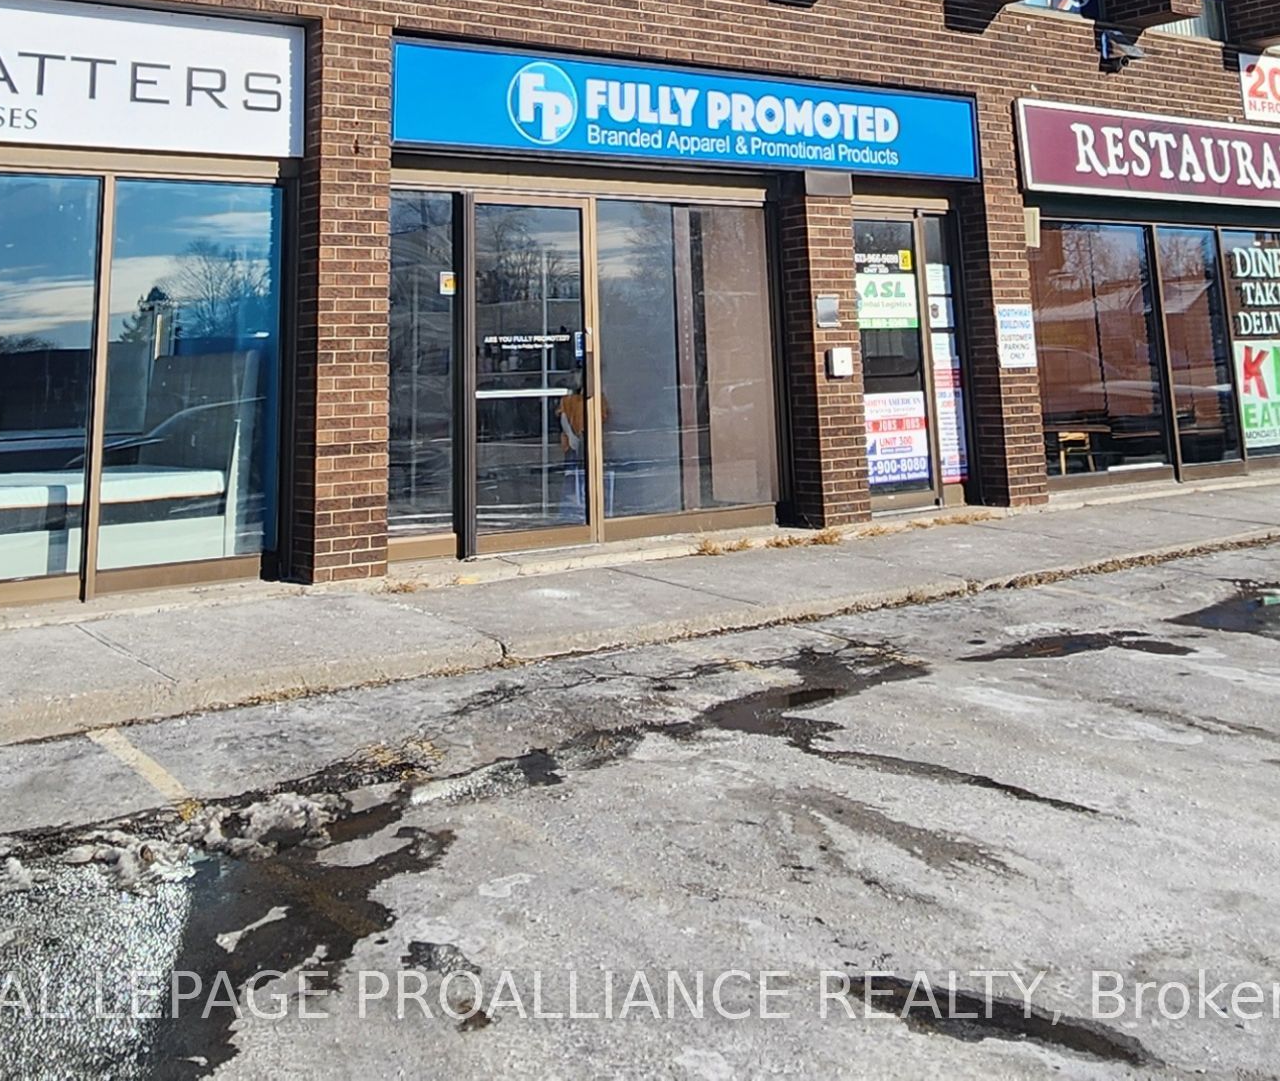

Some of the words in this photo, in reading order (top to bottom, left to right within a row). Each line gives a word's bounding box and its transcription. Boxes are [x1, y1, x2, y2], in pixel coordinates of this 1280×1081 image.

[586, 78, 699, 128] FULLY
[707, 90, 900, 144] PROMOTED
[587, 124, 662, 149] Branded
[667, 133, 730, 156] Apparel
[735, 135, 748, 155] &
[751, 138, 835, 162] Promotional
[838, 143, 899, 167] Products
[863, 281, 906, 298] ASL
[879, 437, 897, 448] UNIT
